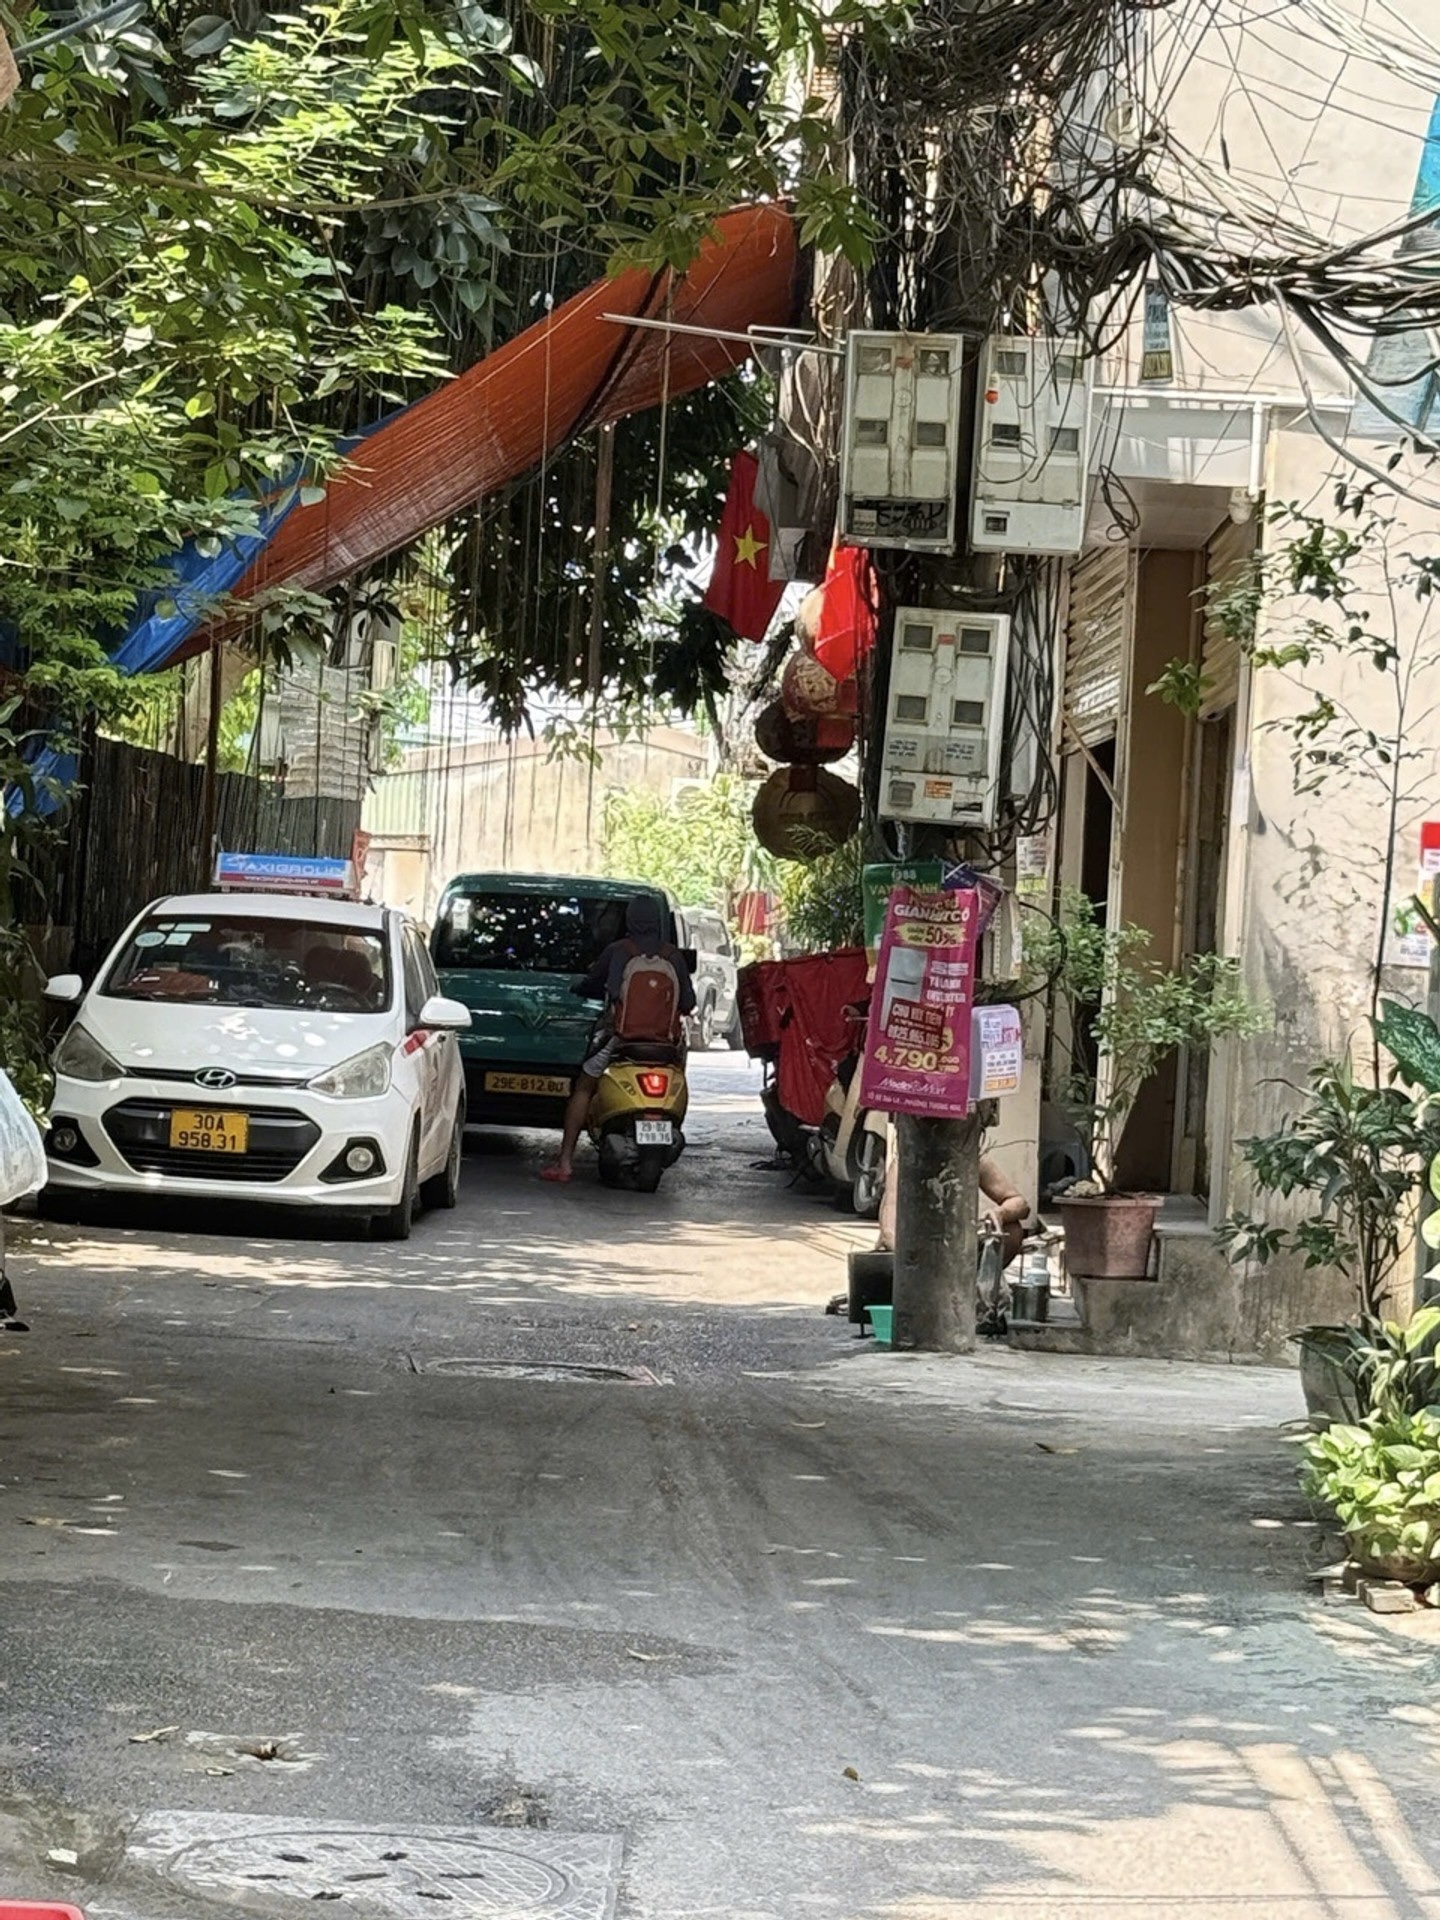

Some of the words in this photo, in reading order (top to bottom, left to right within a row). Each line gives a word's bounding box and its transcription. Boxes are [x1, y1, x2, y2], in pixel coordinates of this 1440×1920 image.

[924, 926, 957, 945] 50%
[874, 1045, 937, 1071] 4.790
[193, 1114, 225, 1132] 30A
[178, 1130, 236, 1150] 958.31
